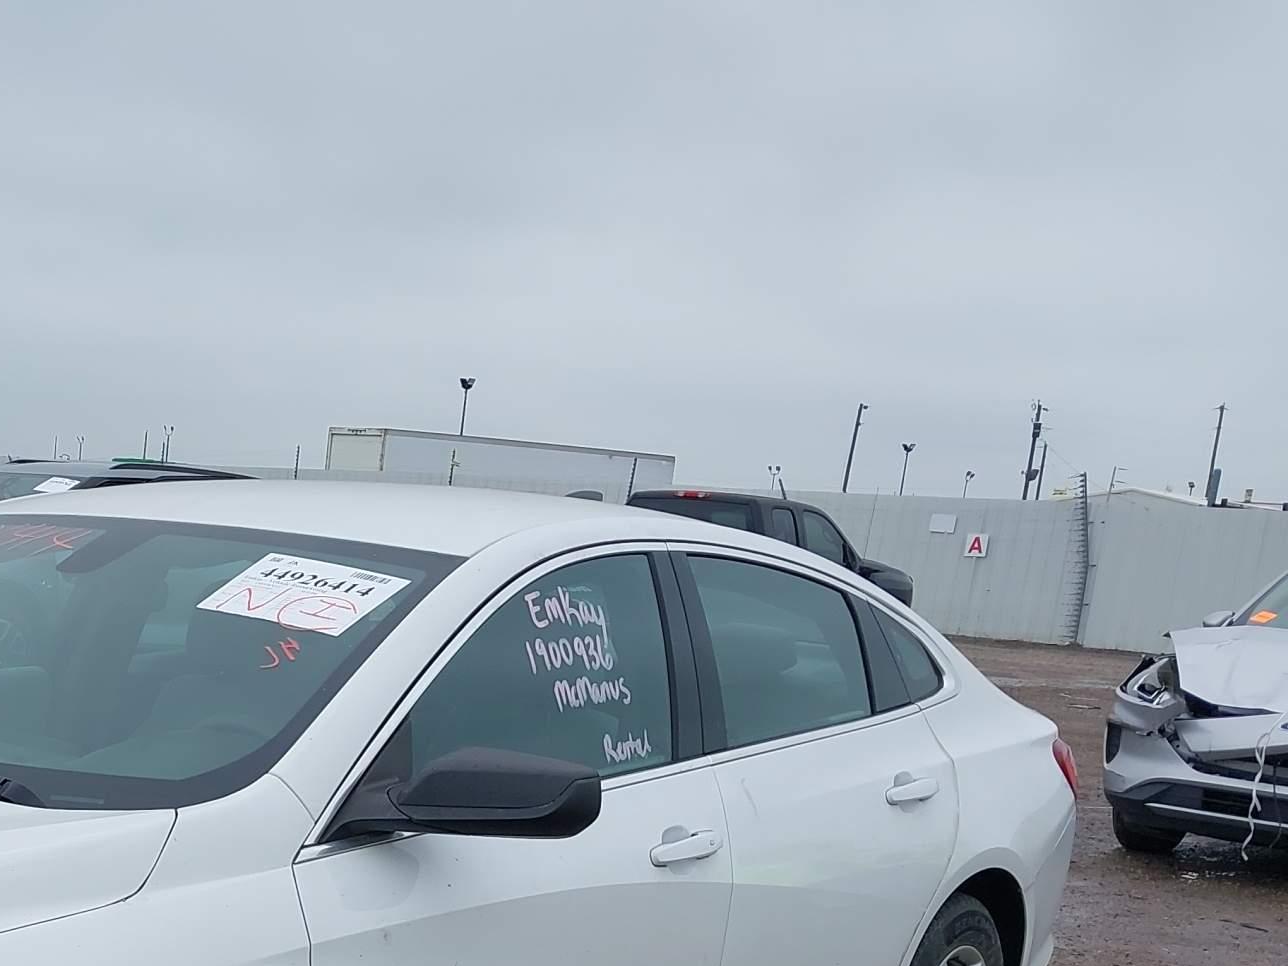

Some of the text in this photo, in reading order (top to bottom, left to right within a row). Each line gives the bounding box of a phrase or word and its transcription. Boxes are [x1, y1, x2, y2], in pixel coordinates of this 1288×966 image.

[967, 536, 983, 554] A
[260, 567, 376, 598] 44926414
[525, 634, 614, 675] 1900936
[553, 676, 632, 713] McManus
[602, 728, 652, 763] Rental
